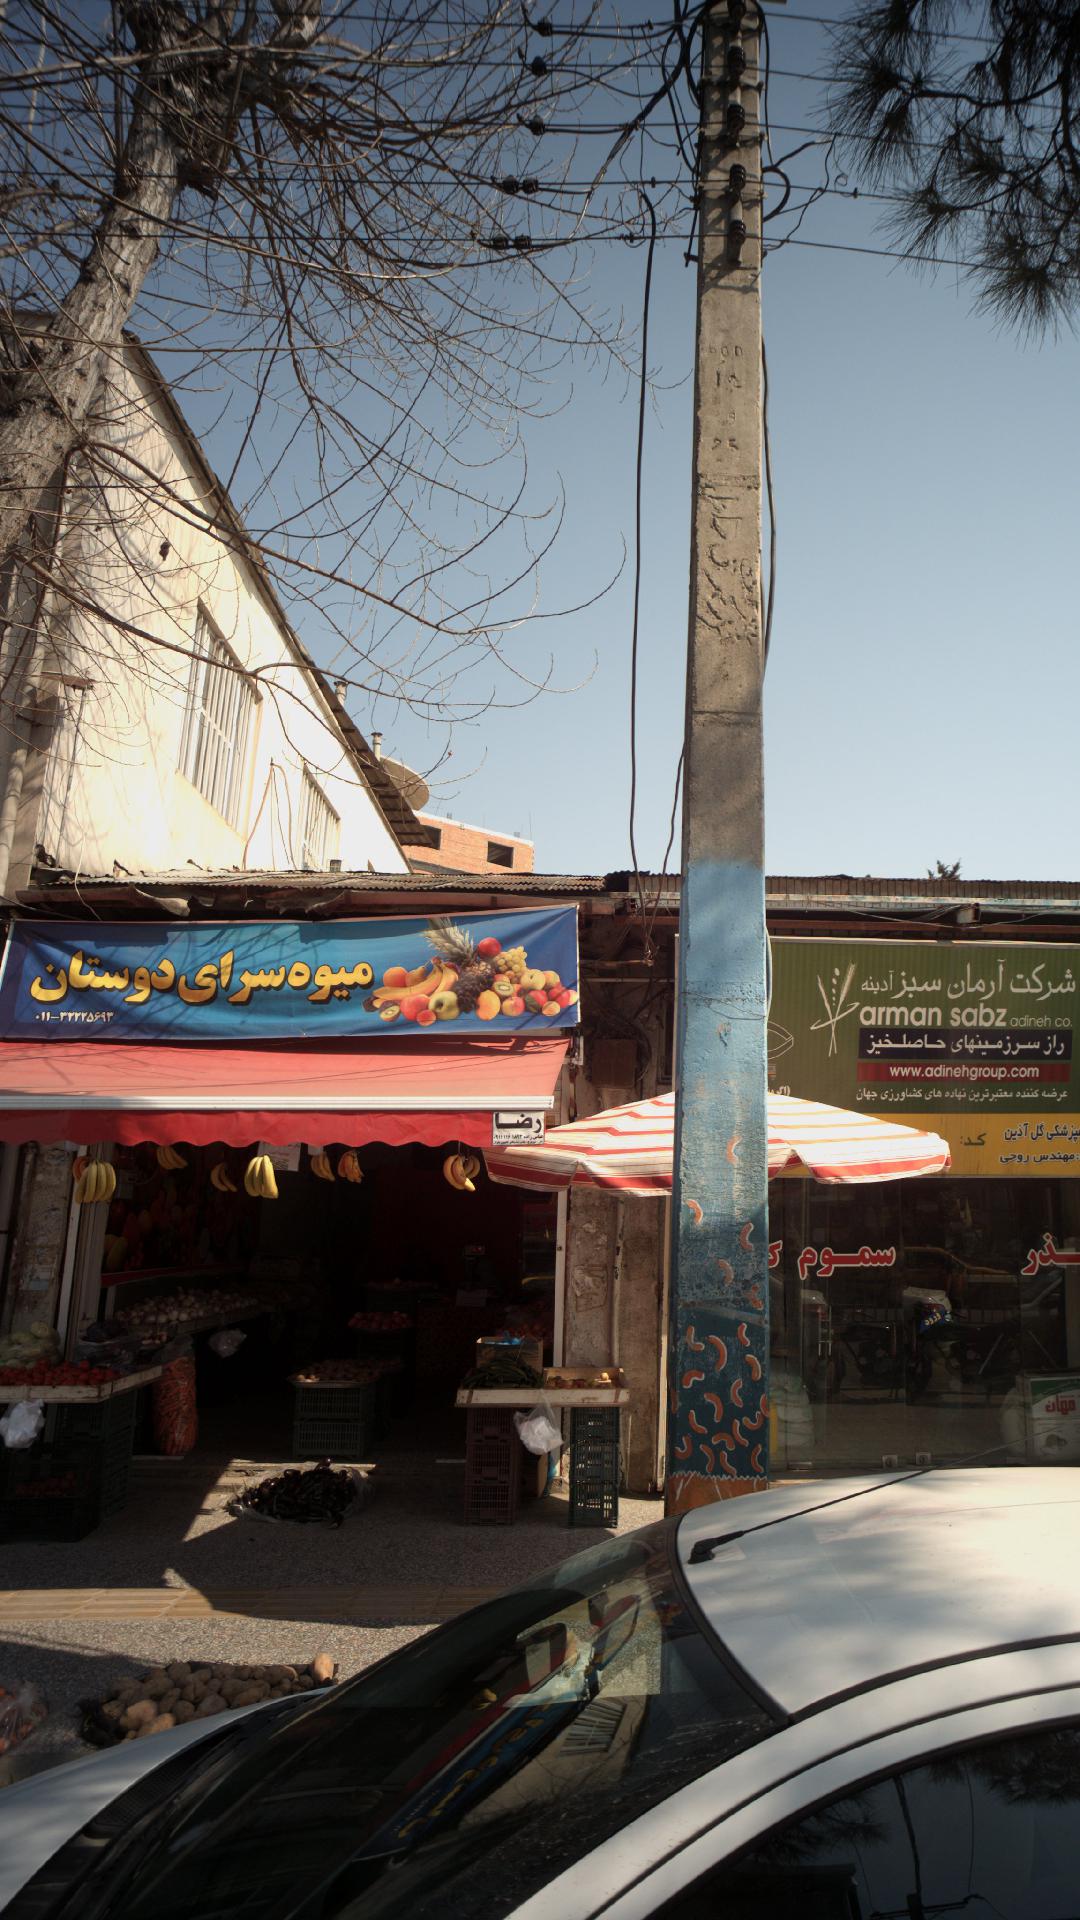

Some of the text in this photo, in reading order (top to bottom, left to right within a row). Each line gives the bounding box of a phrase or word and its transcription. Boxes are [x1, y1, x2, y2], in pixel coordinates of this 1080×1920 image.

[30, 950, 176, 1004] دوستان
[861, 959, 1076, 1001] شرکت آرمان سبز آدینه
[860, 1003, 1073, 1028] arman sabz adineh co.
[866, 1033, 946, 1055] حاصلخیز
[1043, 1034, 1065, 1056] راز
[889, 1064, 1040, 1081] www.adinehgroup.com
[856, 1088, 878, 1101] جهان
[880, 1088, 922, 1102] کشاورزی
[924, 1088, 942, 1101] های
[944, 1088, 967, 1100] نهاده
[1015, 1088, 1039, 1099] کننده
[1041, 1088, 1068, 1102] عرضه
[495, 1112, 542, 1133] رضا
[1004, 1122, 1029, 1141] آذین
[1030, 1123, 1044, 1141] گل
[797, 1245, 896, 1280] سموم
[1020, 1232, 1080, 1276] ذر
